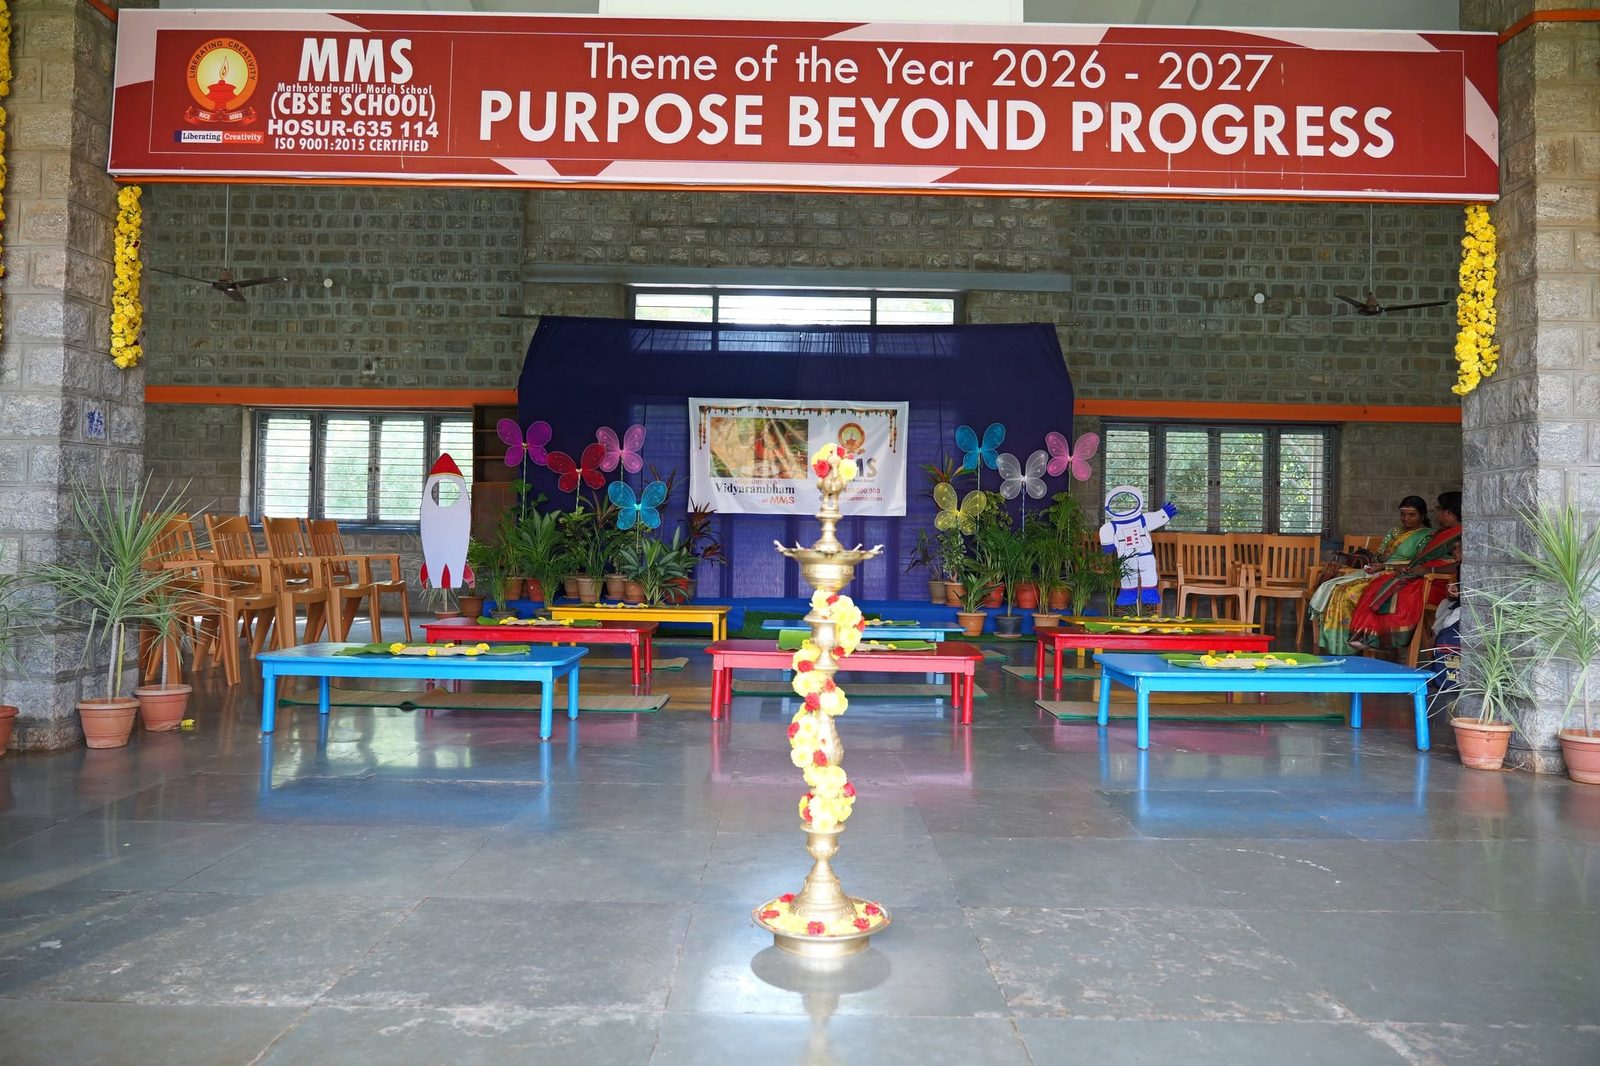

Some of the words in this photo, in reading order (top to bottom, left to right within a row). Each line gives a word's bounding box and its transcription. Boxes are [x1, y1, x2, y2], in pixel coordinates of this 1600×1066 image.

[190, 41, 223, 79] LIBERATING
[228, 41, 256, 80] CREATIVITY
[298, 37, 413, 84] MMS
[584, 42, 717, 80] Theme
[735, 44, 778, 82] of
[796, 46, 859, 84] the
[877, 48, 973, 86] Year
[992, 48, 1106, 89] 2026
[1158, 52, 1273, 92] 2027
[277, 83, 362, 94] Mathakondapalli
[366, 84, 396, 94] Model
[400, 85, 432, 95] School
[271, 92, 332, 119] (CBSE
[340, 93, 436, 122] SCHOOL)
[268, 119, 392, 137] HOSUR-635
[400, 121, 438, 138] 114
[479, 90, 763, 146] PURPOSE
[788, 95, 1046, 150] BEYOND
[1072, 101, 1395, 158] PROGRESS
[182, 132, 221, 141] Liberating
[223, 132, 262, 142] Creativity
[275, 137, 295, 150] ISO
[300, 138, 365, 150] 9001:2015
[369, 139, 429, 151] CERTIFIED
[715, 482, 795, 496] Vidyarambham
